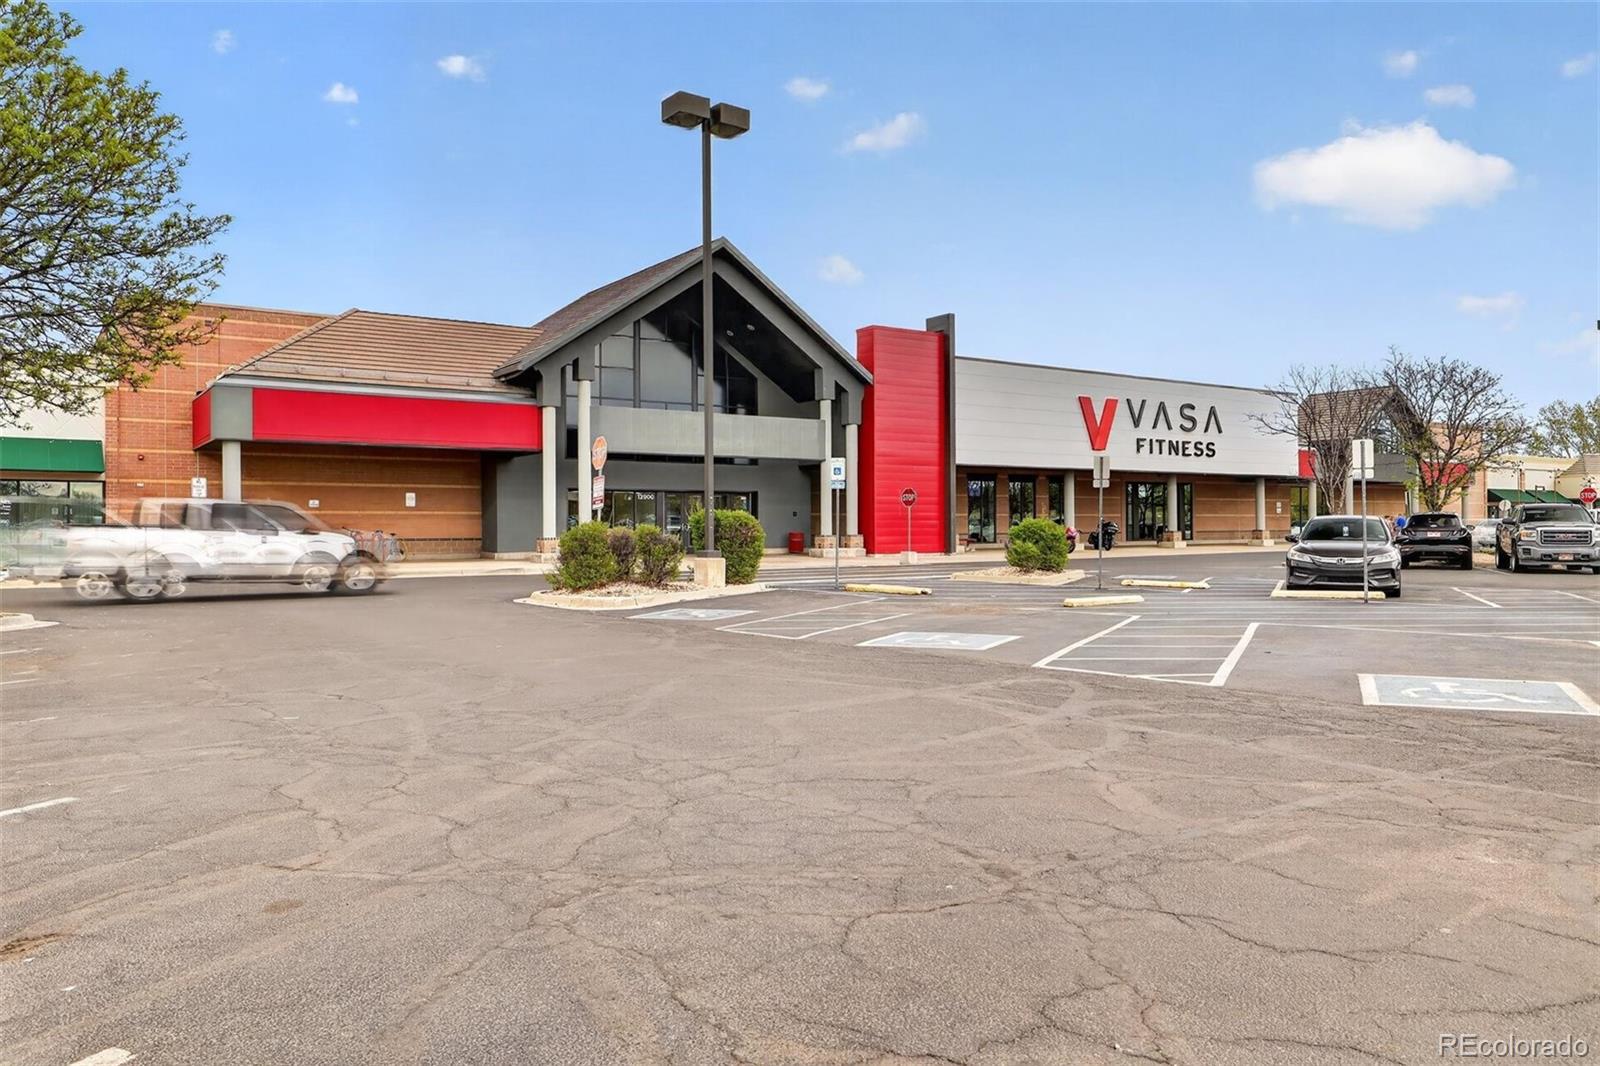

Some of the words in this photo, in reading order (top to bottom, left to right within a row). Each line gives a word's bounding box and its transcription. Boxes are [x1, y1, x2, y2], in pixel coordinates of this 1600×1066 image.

[1126, 398, 1223, 434] VASA
[1136, 438, 1216, 457] FITNESS
[903, 494, 916, 502] STOP
